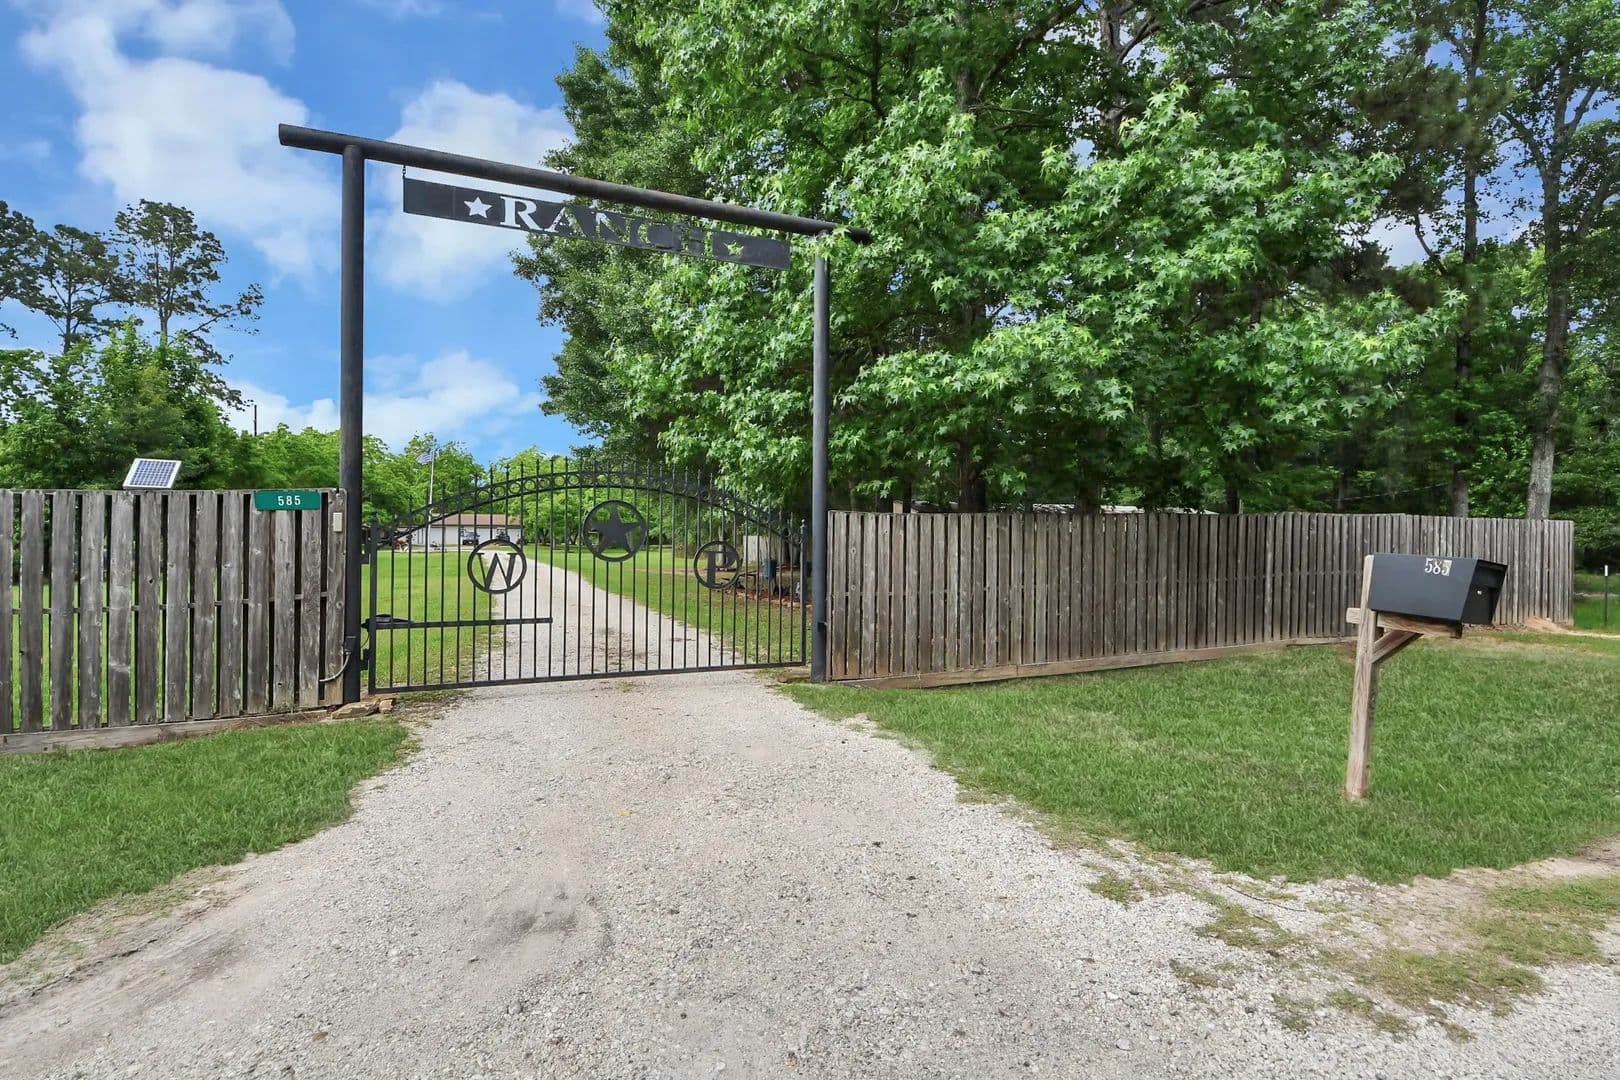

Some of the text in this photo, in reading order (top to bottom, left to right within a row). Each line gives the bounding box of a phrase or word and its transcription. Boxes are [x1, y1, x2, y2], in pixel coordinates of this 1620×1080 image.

[499, 195, 714, 257] RANCH
[277, 495, 301, 506] 585
[474, 552, 520, 591] W
[1424, 557, 1452, 576] 585
